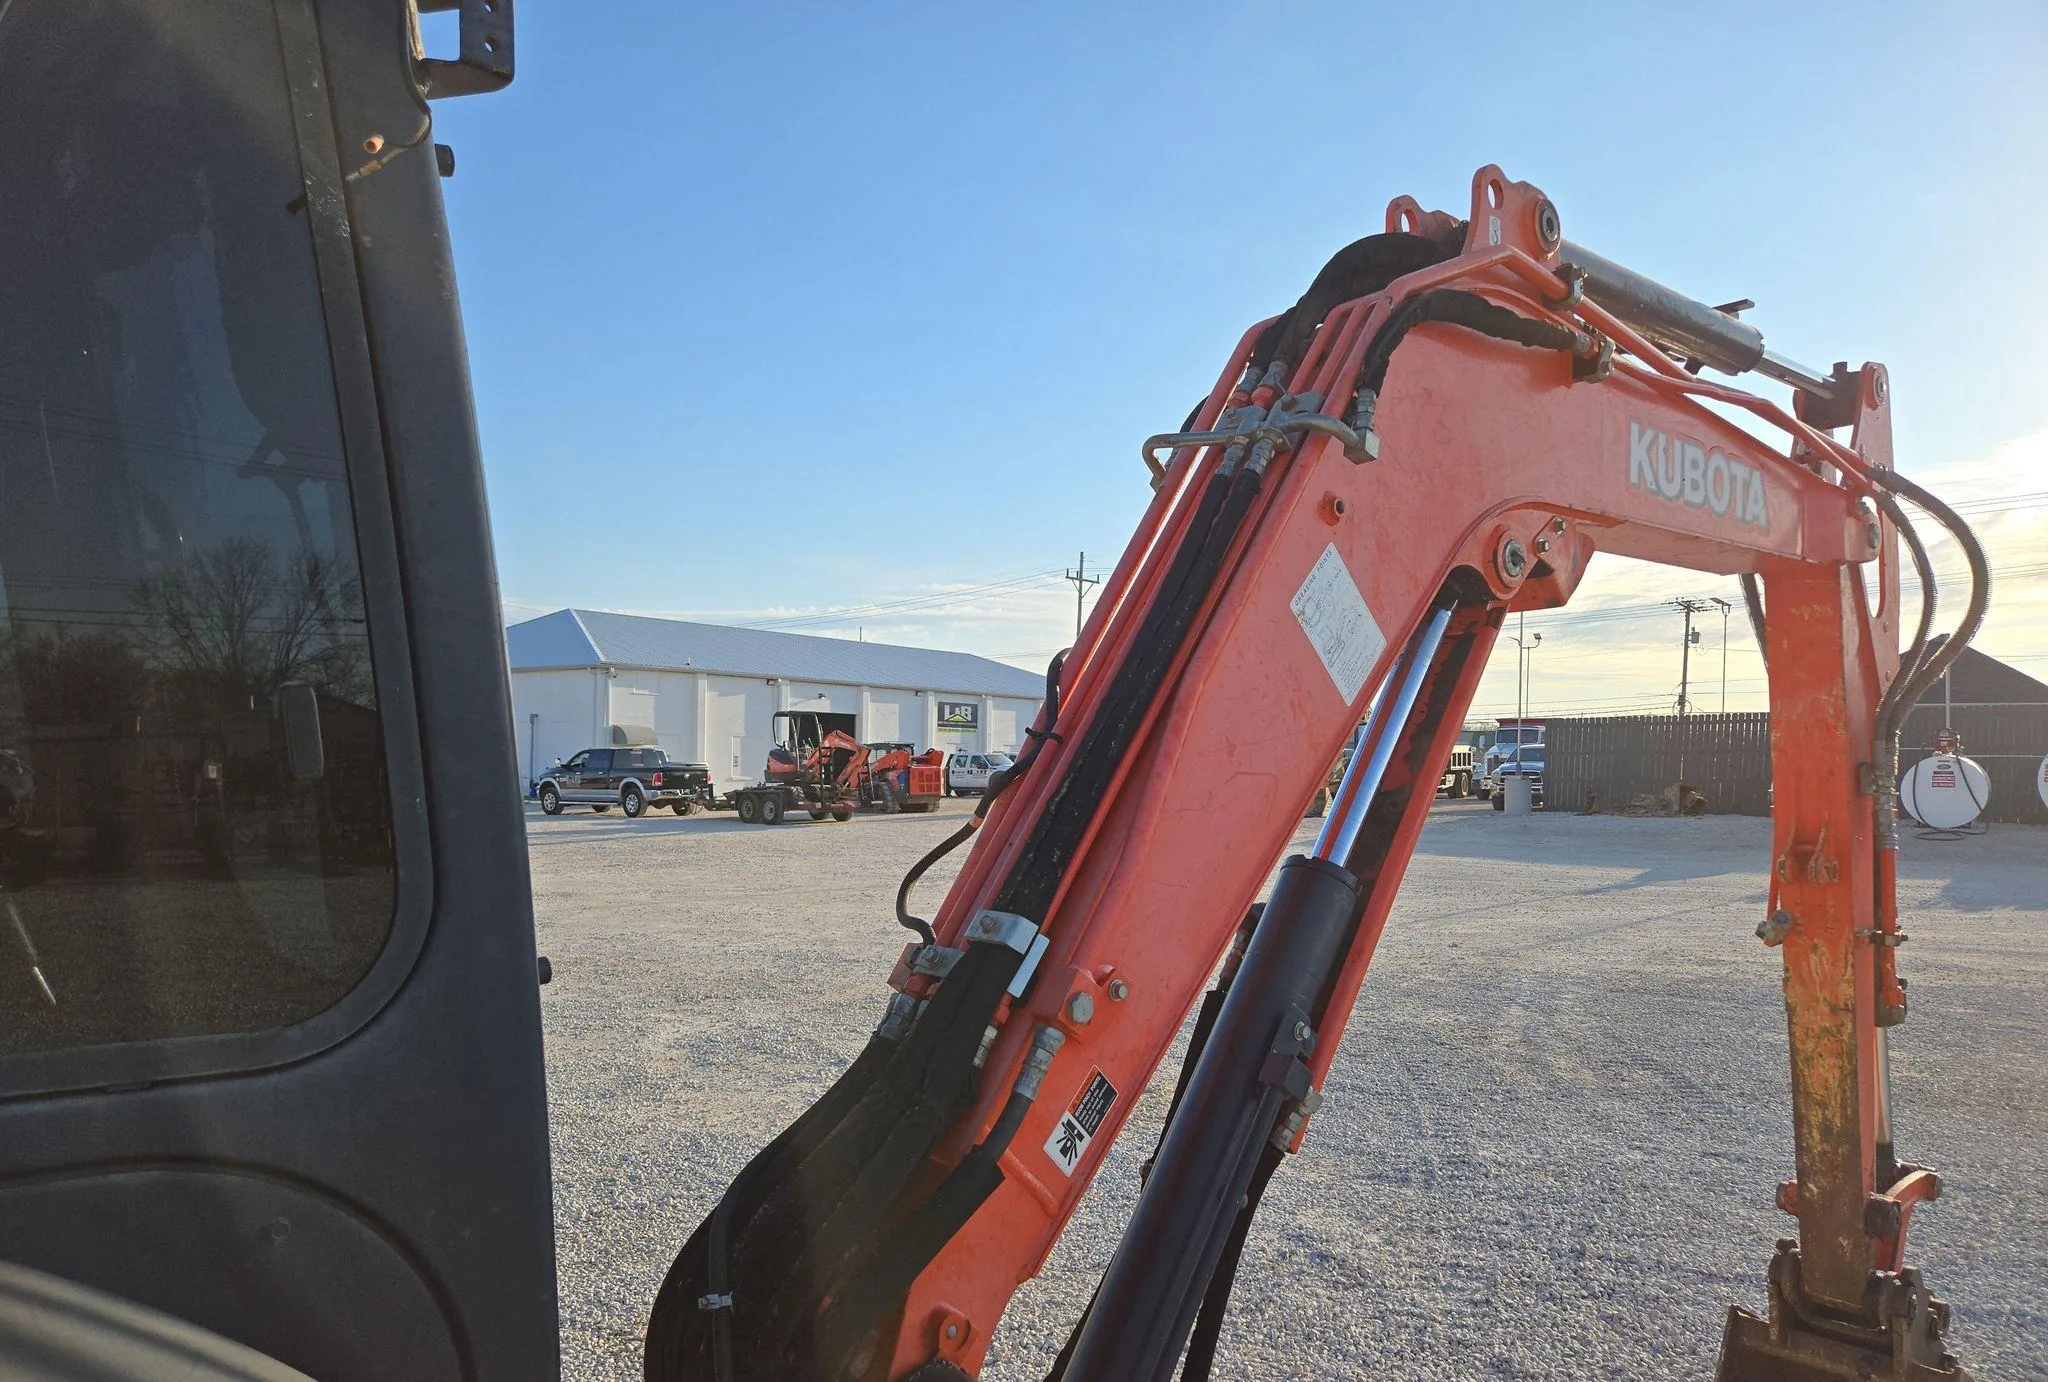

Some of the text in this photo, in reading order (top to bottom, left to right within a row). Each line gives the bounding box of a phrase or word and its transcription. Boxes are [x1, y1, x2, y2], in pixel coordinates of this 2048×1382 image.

[1629, 419, 1769, 530] KUBOTA
[1295, 550, 1332, 606] GREASING POINTS
[1082, 1090, 1091, 1104] PINCH
